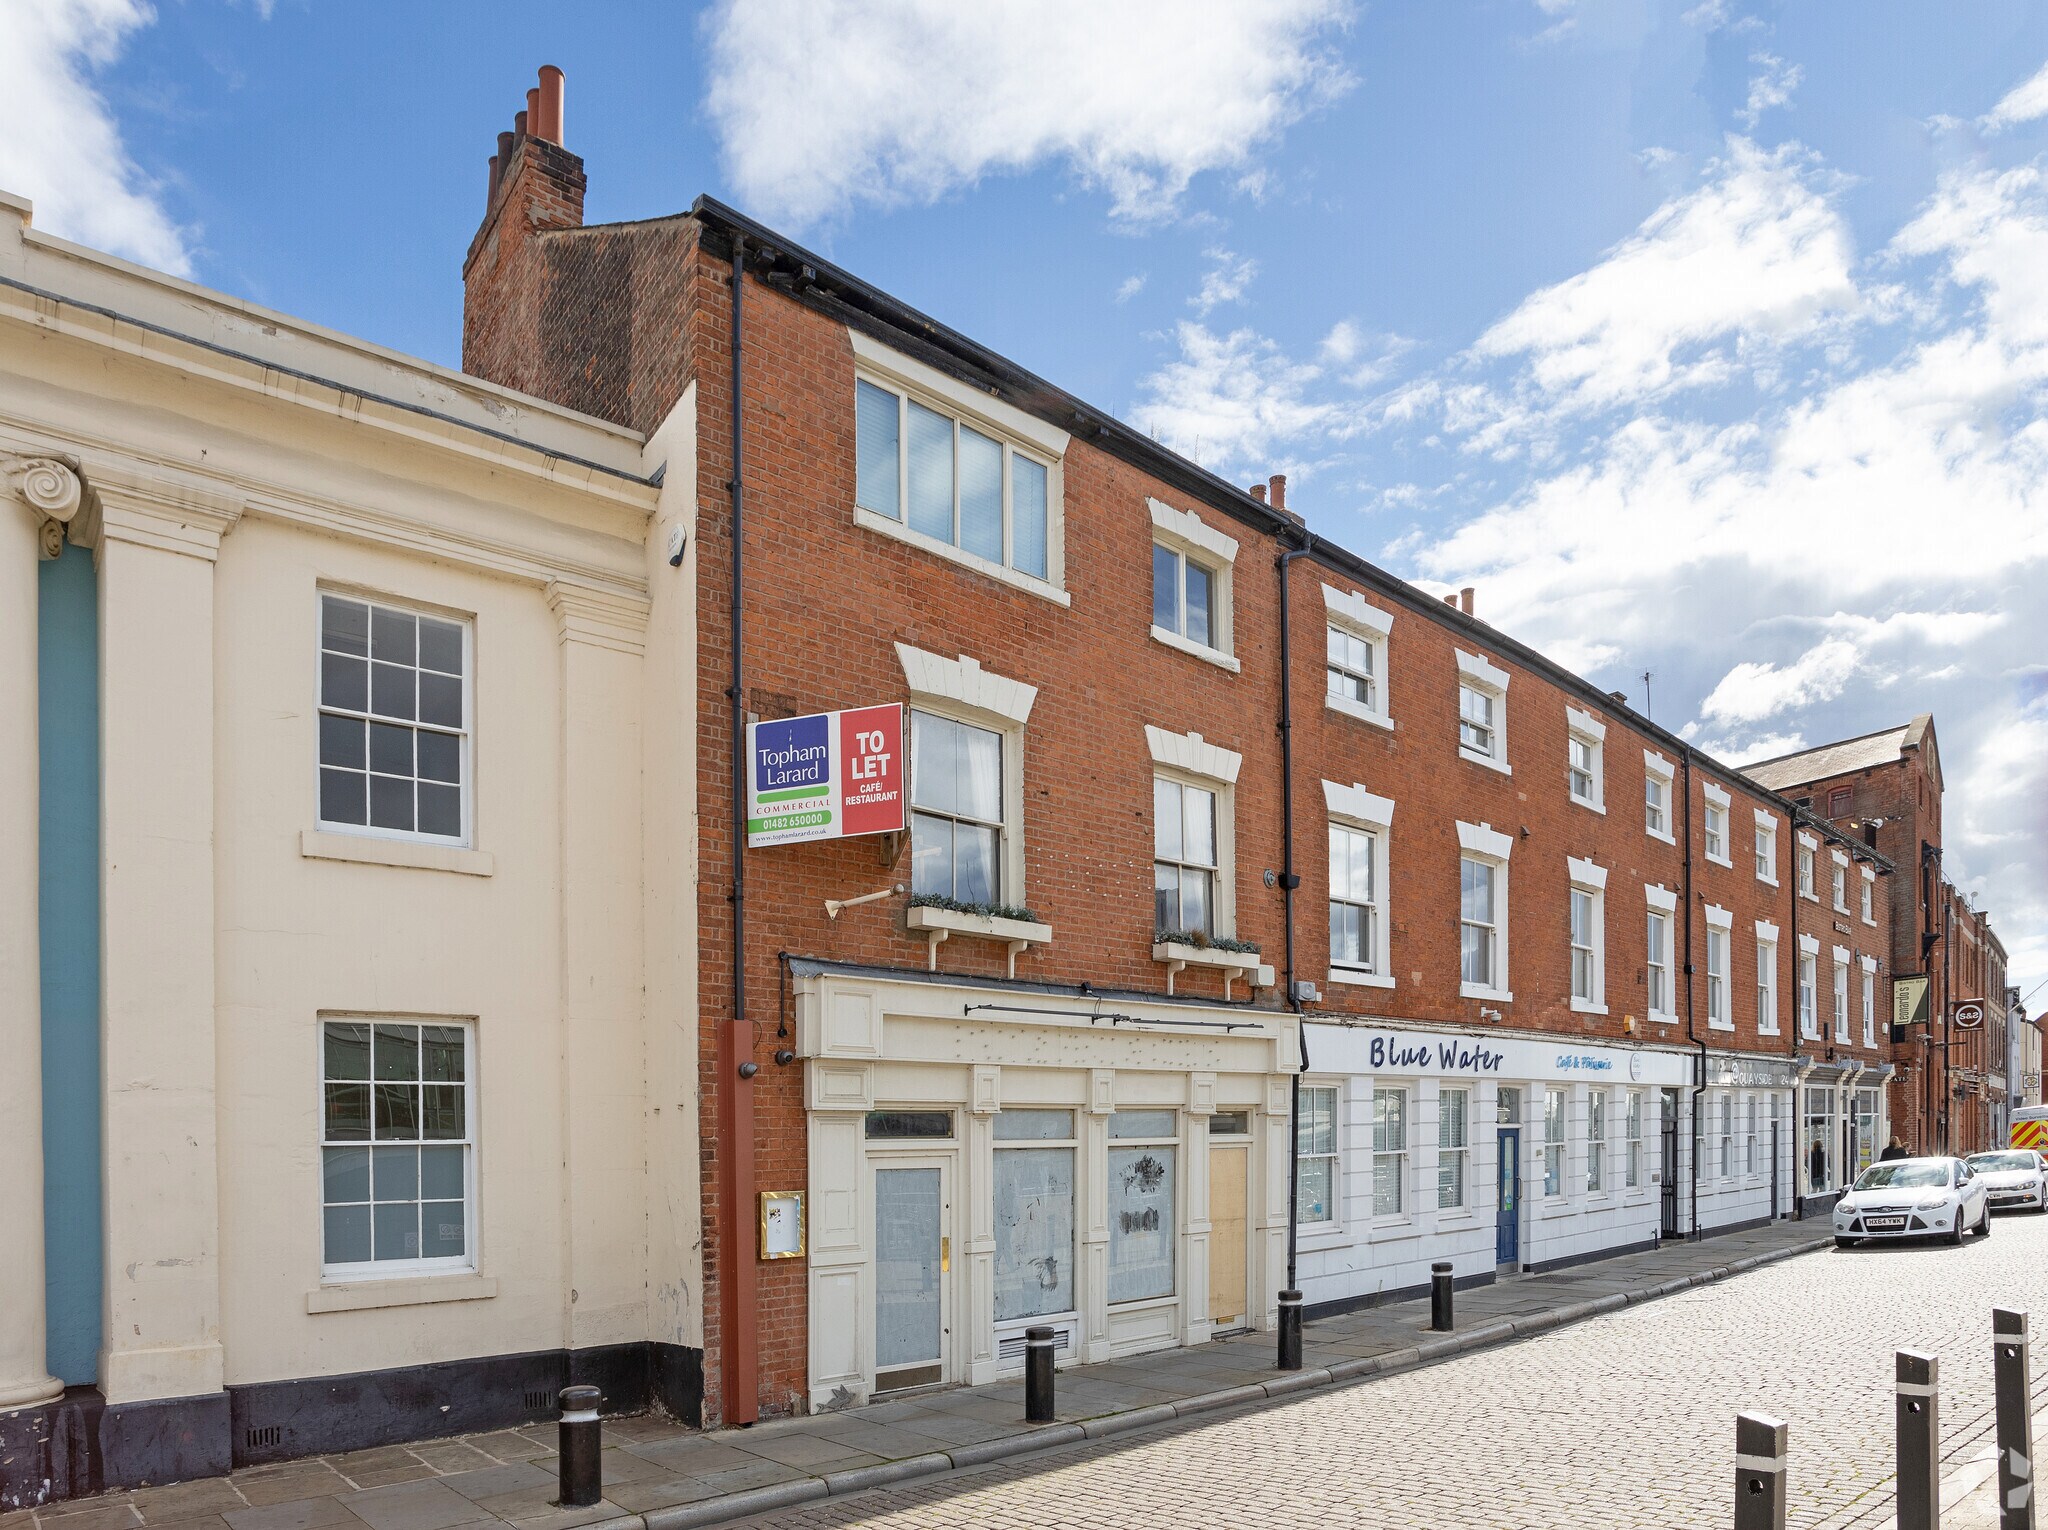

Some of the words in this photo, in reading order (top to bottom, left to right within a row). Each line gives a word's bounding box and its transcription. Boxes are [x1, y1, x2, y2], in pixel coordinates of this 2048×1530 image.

[856, 730, 885, 755] TO
[759, 744, 826, 769] Topham
[851, 753, 891, 779] LET
[767, 760, 819, 785] Larard
[860, 781, 883, 793] CAFÉ/
[756, 799, 830, 815] COMMERCIAL
[845, 791, 898, 806] RESTAURANT
[763, 818, 788, 830] 01482
[789, 813, 823, 827] 650000
[755, 828, 827, 842] www.tophamlarard.co.uk
[1370, 1036, 1432, 1068] Blue
[1438, 1039, 1504, 1072] Water
